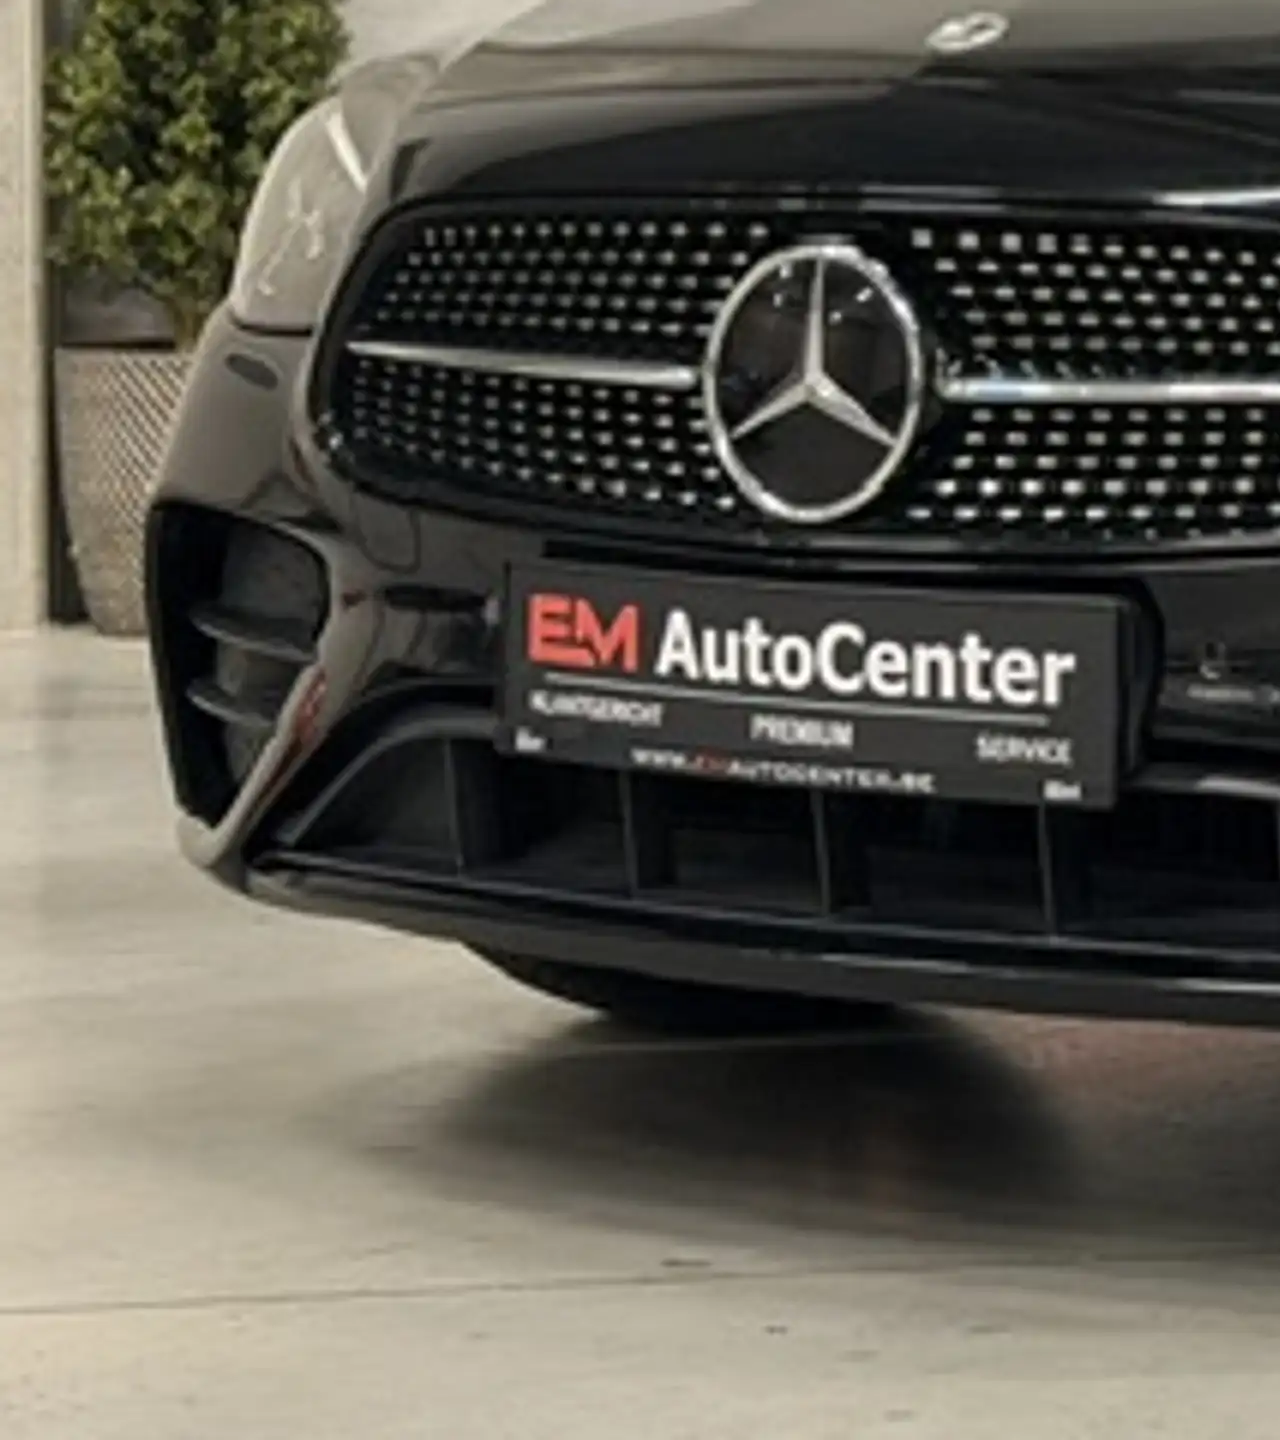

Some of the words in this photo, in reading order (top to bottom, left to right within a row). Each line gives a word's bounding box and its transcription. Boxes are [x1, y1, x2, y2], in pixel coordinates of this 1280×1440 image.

[527, 593, 640, 673] EM
[655, 608, 1077, 706] AutoCenter
[750, 713, 854, 749] PREMIUM
[975, 732, 1073, 766] SERVICE
